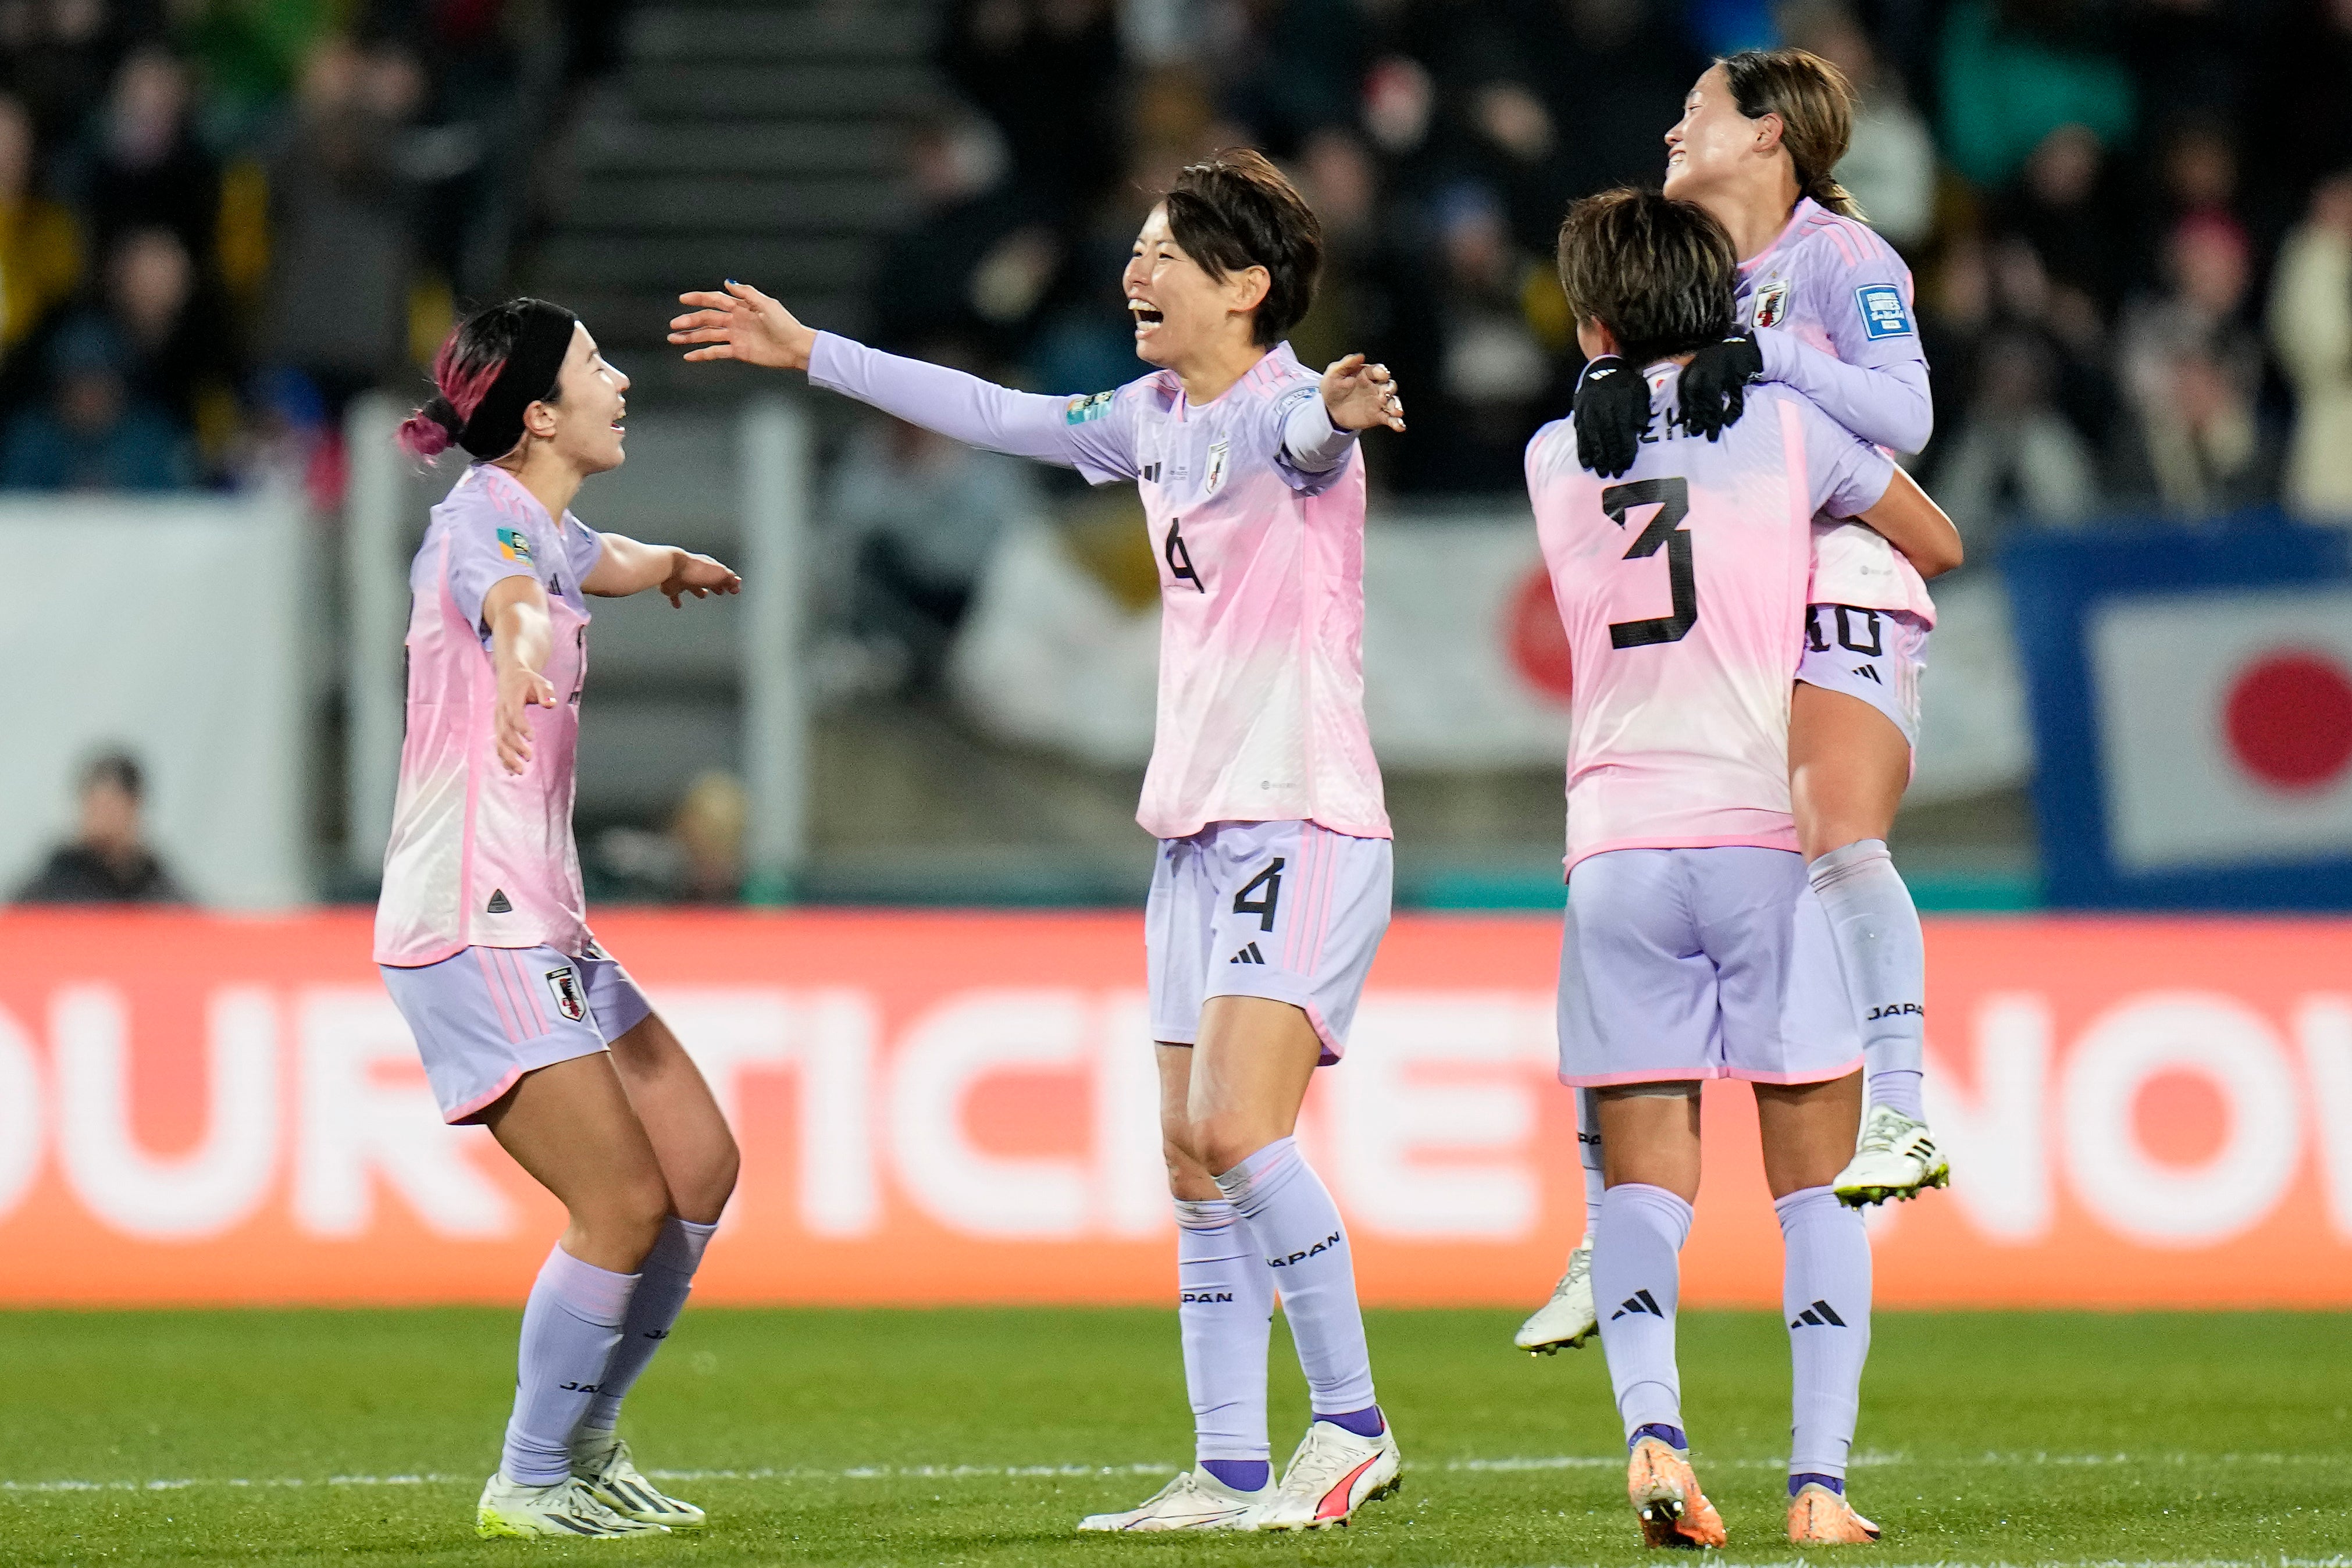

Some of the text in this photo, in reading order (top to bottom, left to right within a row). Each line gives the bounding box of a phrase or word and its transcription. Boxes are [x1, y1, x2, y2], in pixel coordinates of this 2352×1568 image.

[1166, 517, 1205, 594] 4
[1602, 476, 1698, 650] 3
[1233, 857, 1285, 932] 4
[0, 983, 512, 1236] UR
[1864, 989, 2352, 1248] NO
[1181, 1293, 1233, 1303] PAN
